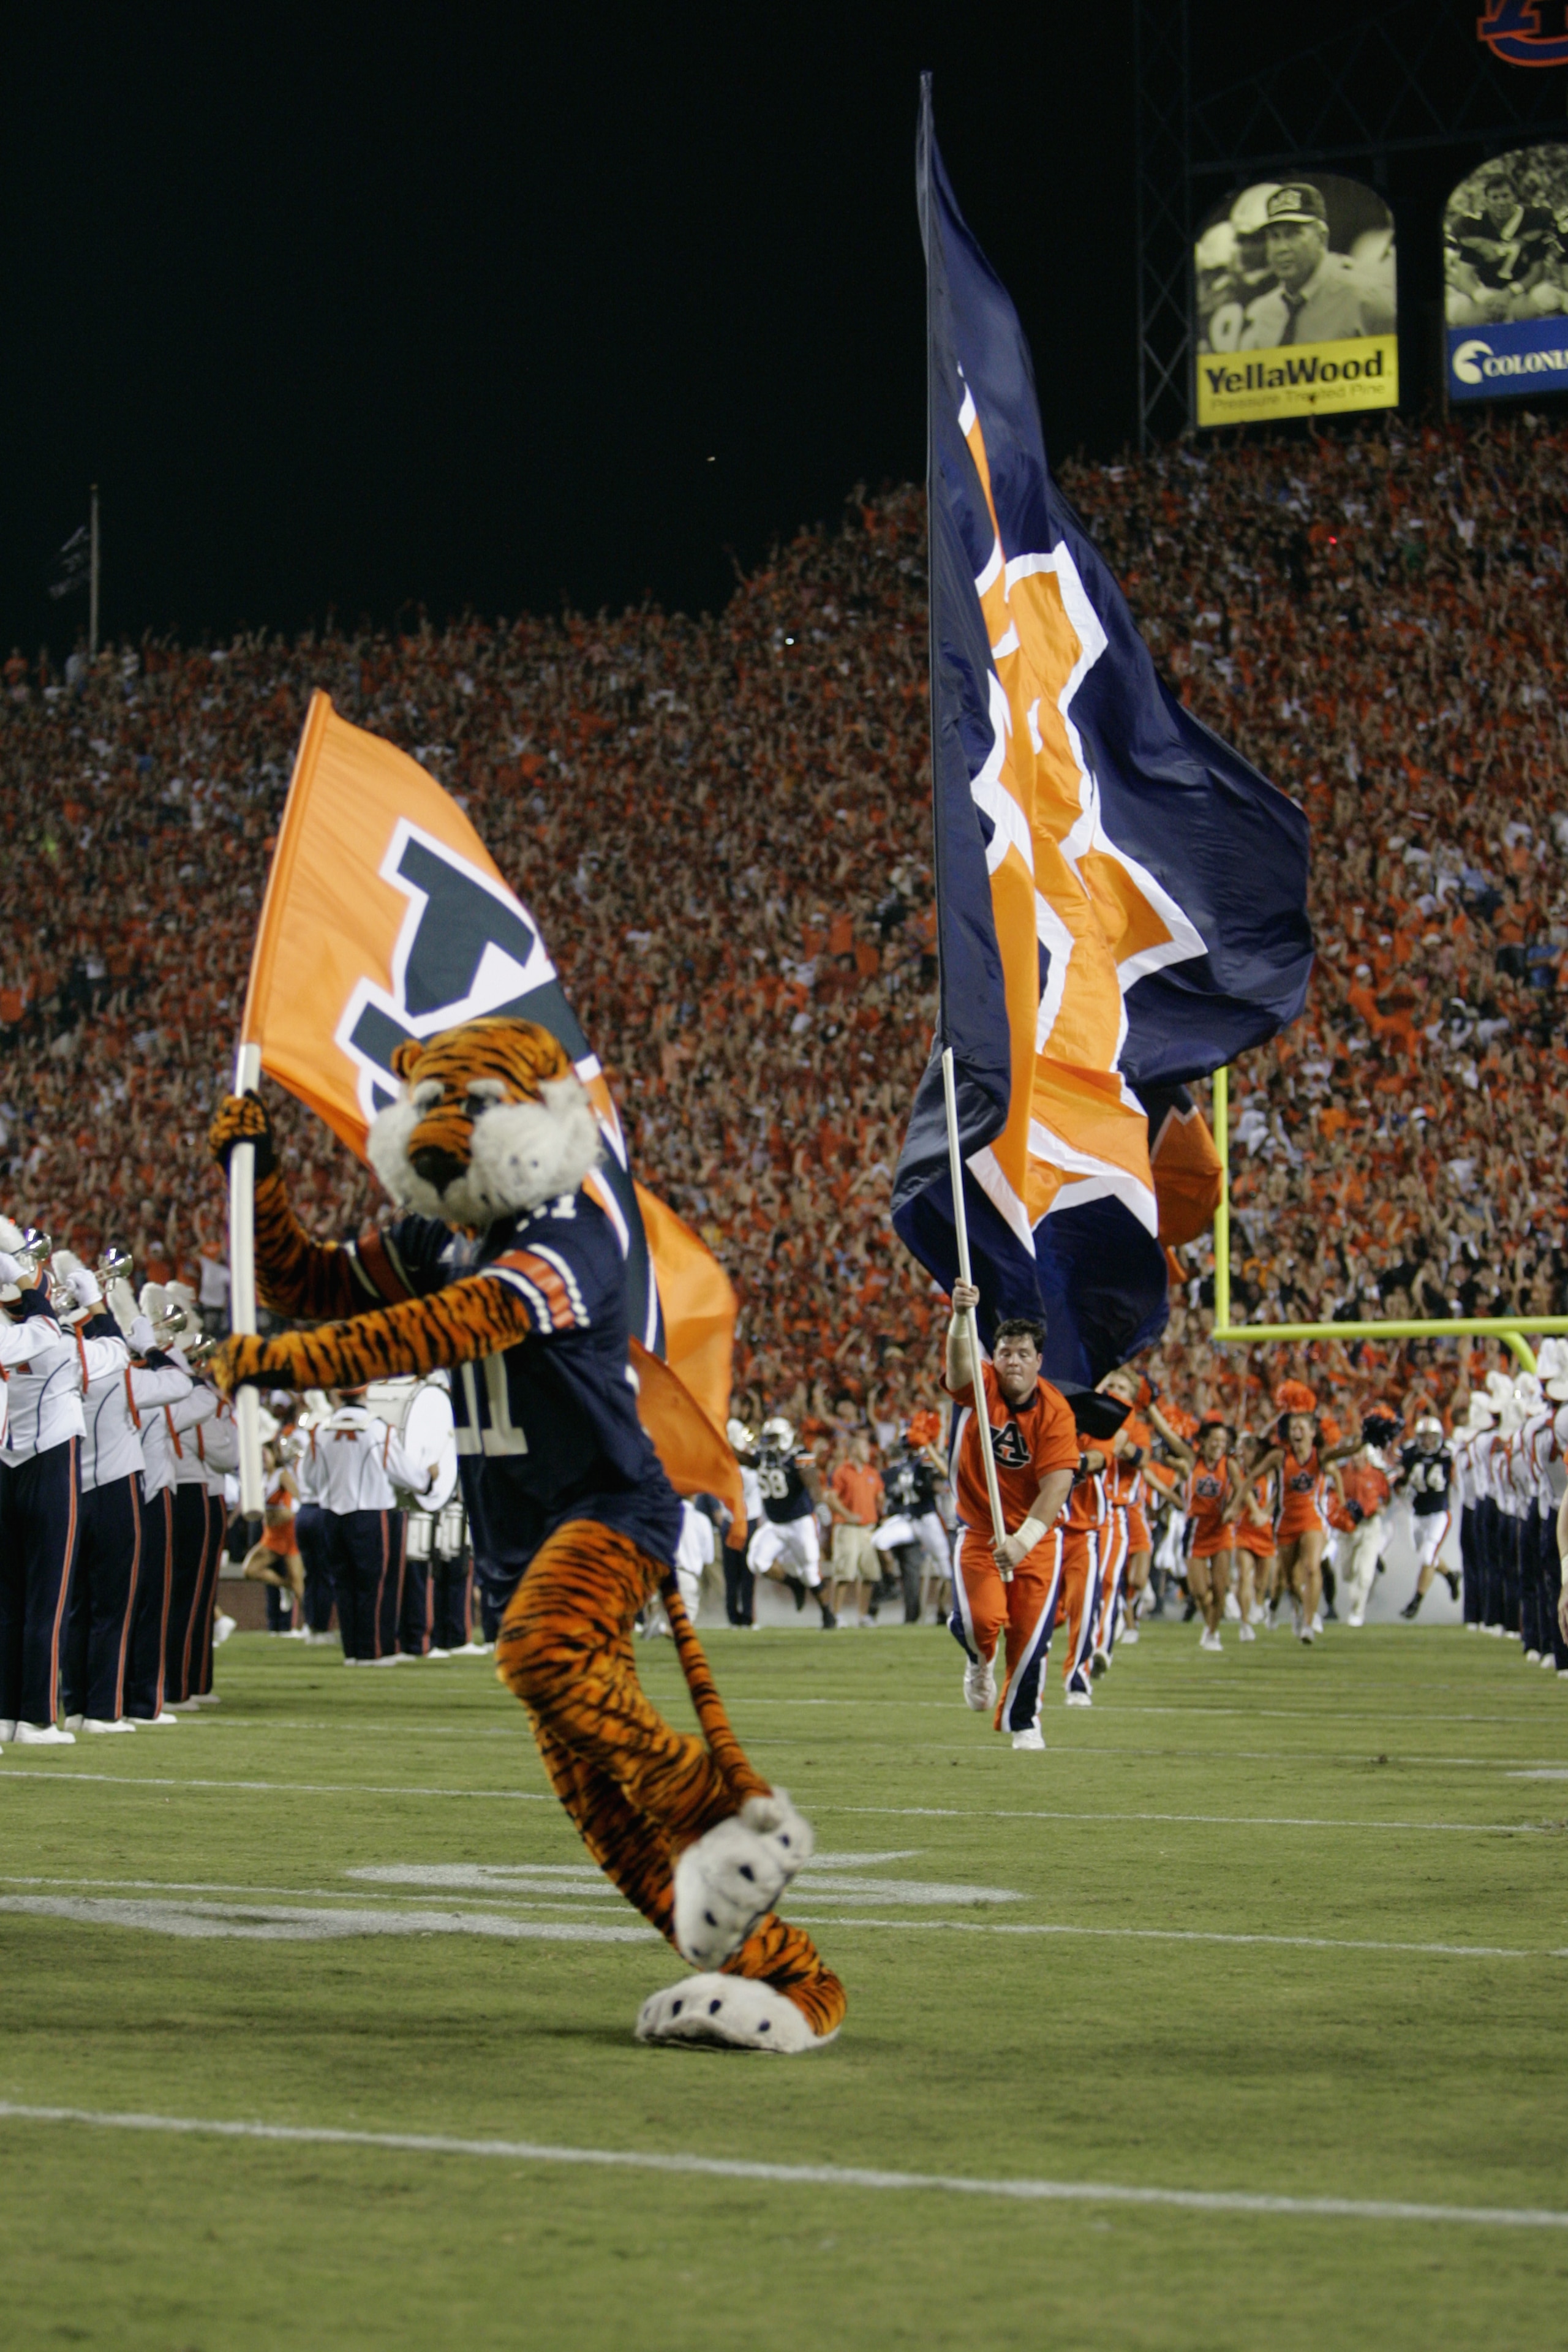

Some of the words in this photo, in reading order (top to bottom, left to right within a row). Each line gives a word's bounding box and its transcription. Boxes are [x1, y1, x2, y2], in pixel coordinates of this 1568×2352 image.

[1206, 350, 1383, 394] YellaWood
[1482, 348, 1568, 377] COLONI
[1286, 386, 1346, 403] Treted
[1351, 382, 1385, 396] Pine
